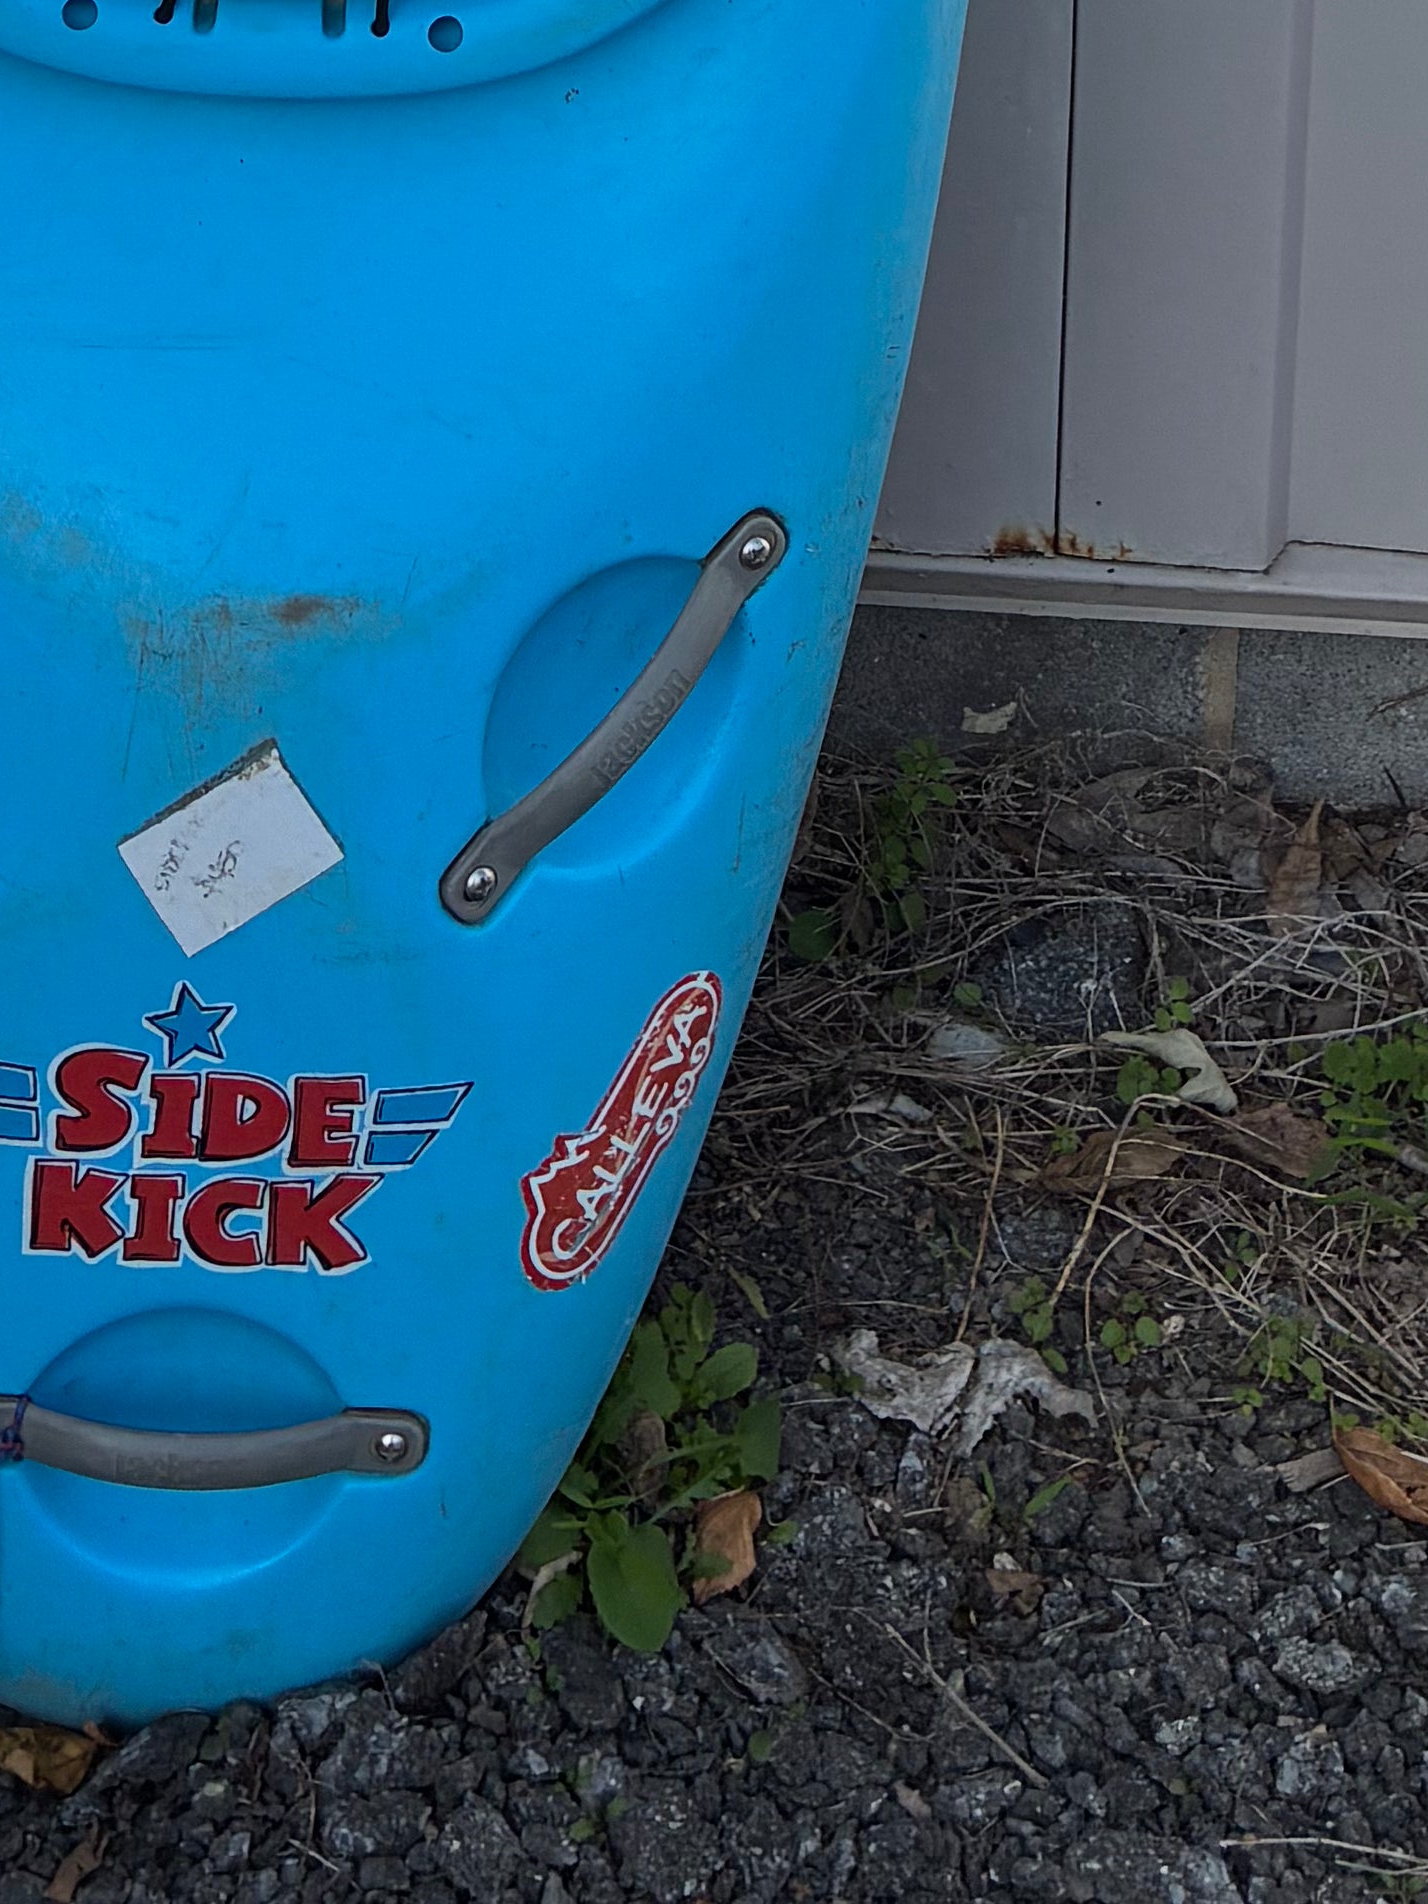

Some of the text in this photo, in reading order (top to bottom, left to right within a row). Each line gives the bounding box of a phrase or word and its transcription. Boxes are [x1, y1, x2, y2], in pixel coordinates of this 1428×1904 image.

[590, 668, 692, 786] Jackson
[54, 1046, 368, 1169] SIDE
[551, 1002, 708, 1261] CALLEVA
[29, 1158, 385, 1272] KICK
